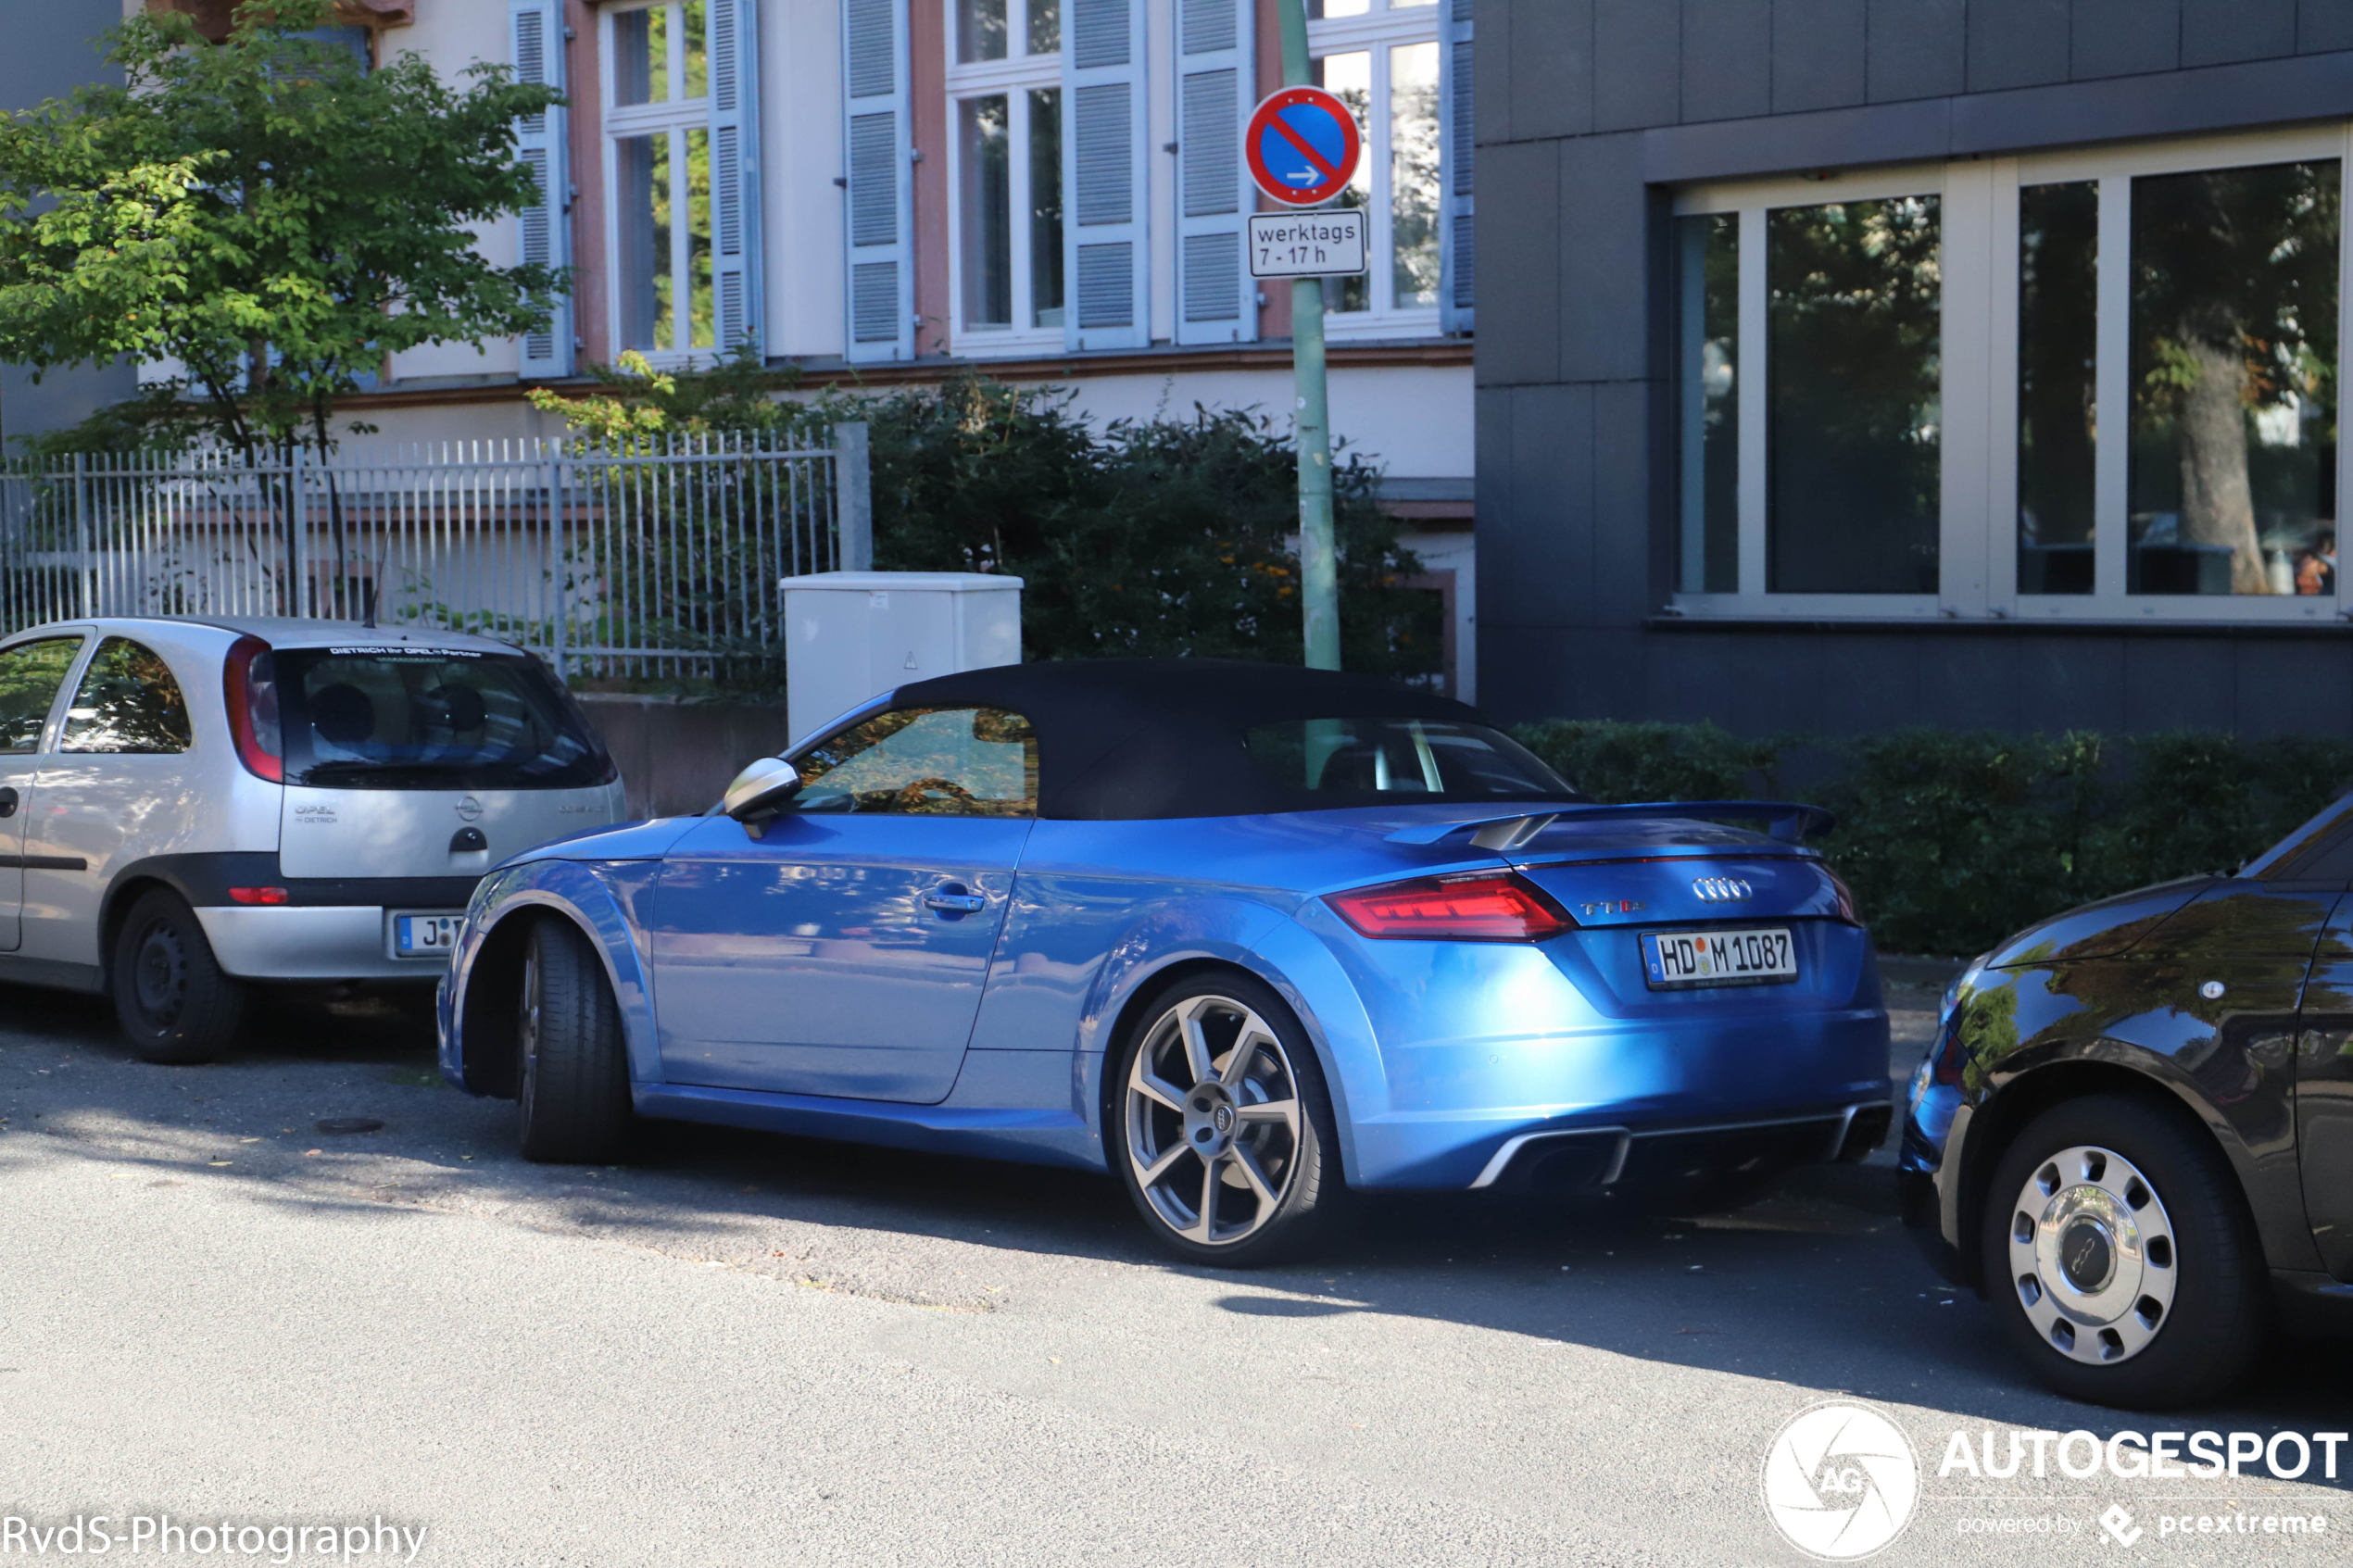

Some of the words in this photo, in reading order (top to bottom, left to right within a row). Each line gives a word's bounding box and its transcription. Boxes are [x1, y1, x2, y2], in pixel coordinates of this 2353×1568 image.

[1258, 222, 1355, 245] werktags
[1260, 248, 1269, 266] 7
[1288, 246, 1308, 264] 17
[1315, 245, 1326, 263] h
[442, 649, 482, 658] Partner
[295, 805, 335, 814] OPEL
[402, 935, 409, 944] D
[423, 920, 437, 946] J
[1660, 939, 1696, 975] HD
[1709, 937, 1730, 972] M
[1731, 934, 1788, 972] 1087
[1651, 963, 1658, 973] D
